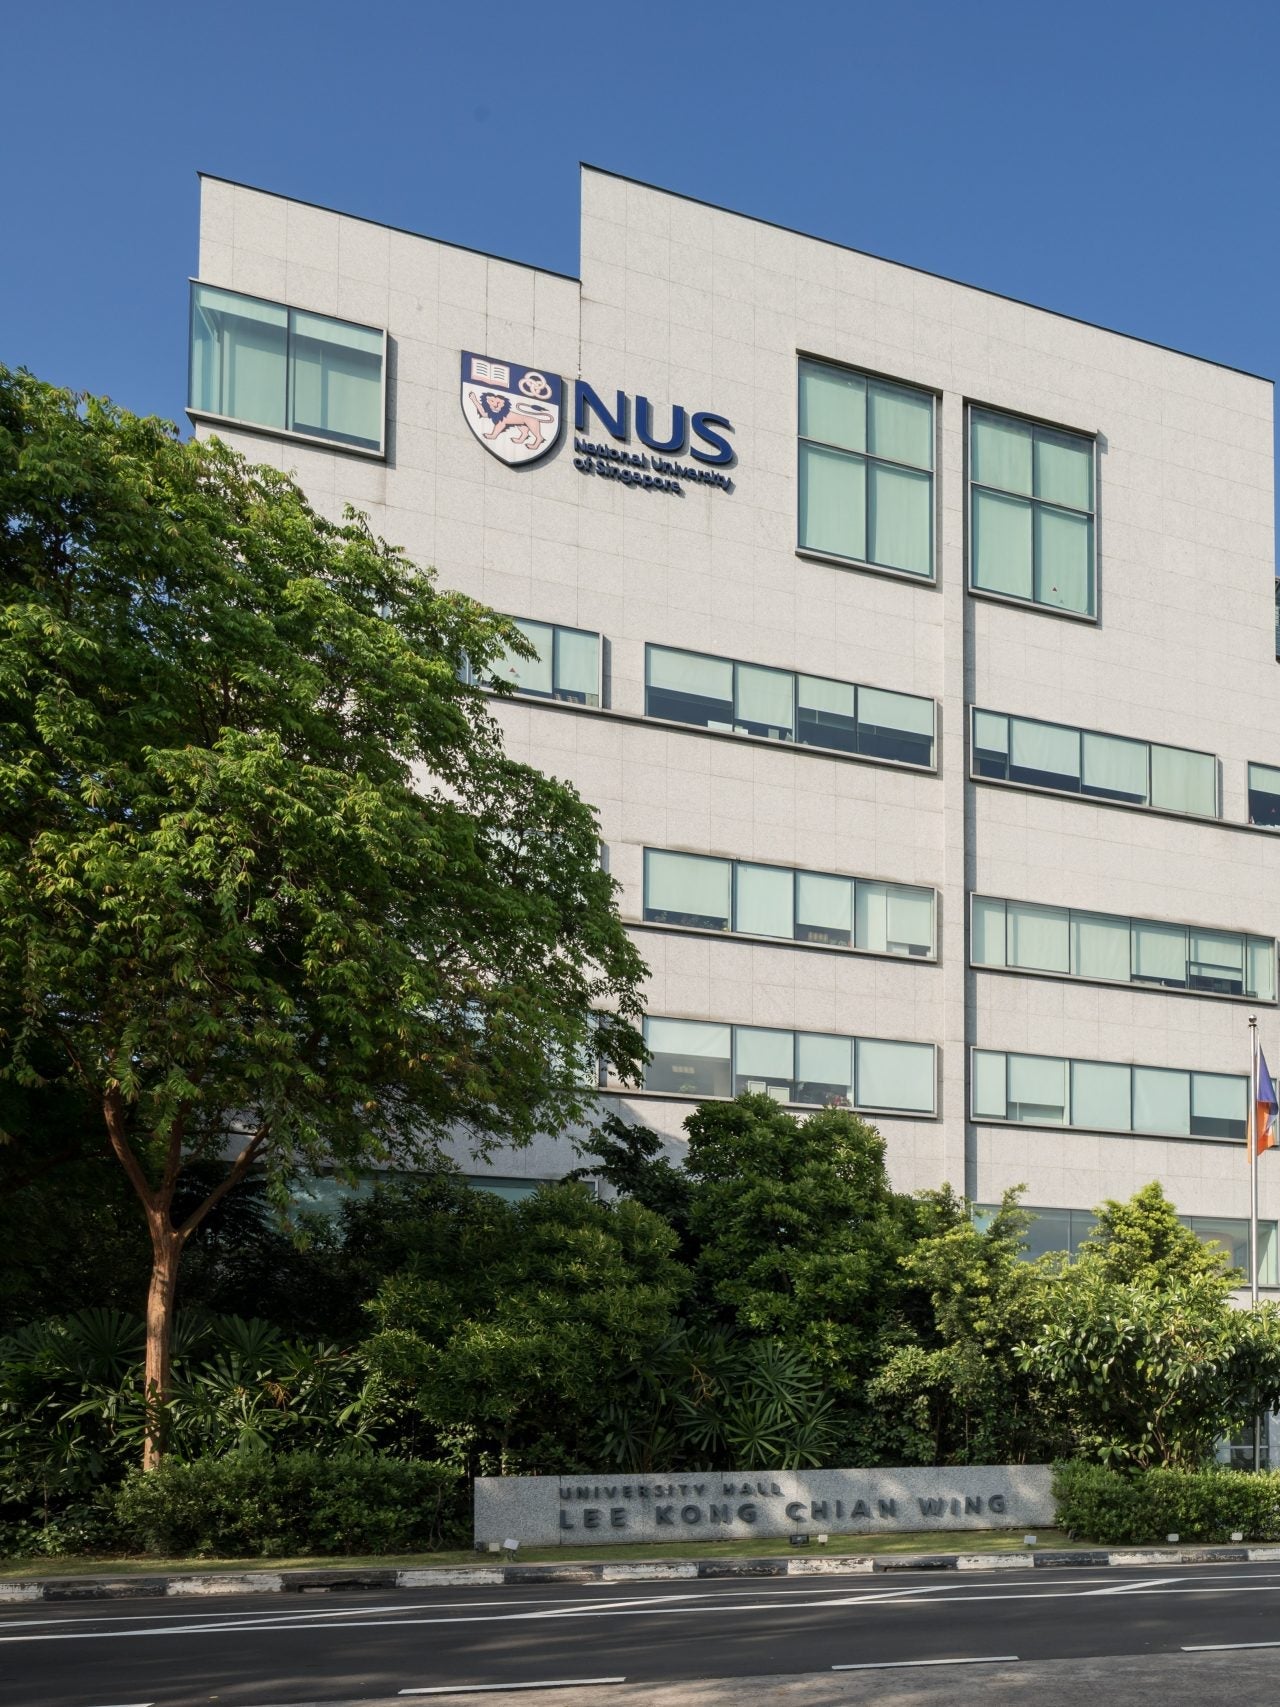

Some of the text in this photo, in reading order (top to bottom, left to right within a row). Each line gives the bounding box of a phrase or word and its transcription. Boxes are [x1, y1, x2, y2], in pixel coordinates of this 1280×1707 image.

[575, 379, 734, 464] NUS
[573, 457, 680, 492] of Singapore
[574, 437, 731, 489] National University
[559, 1482, 784, 1500] UNIVERSITY HALL
[559, 1494, 1007, 1529] LEE KONG CHIAN WING
